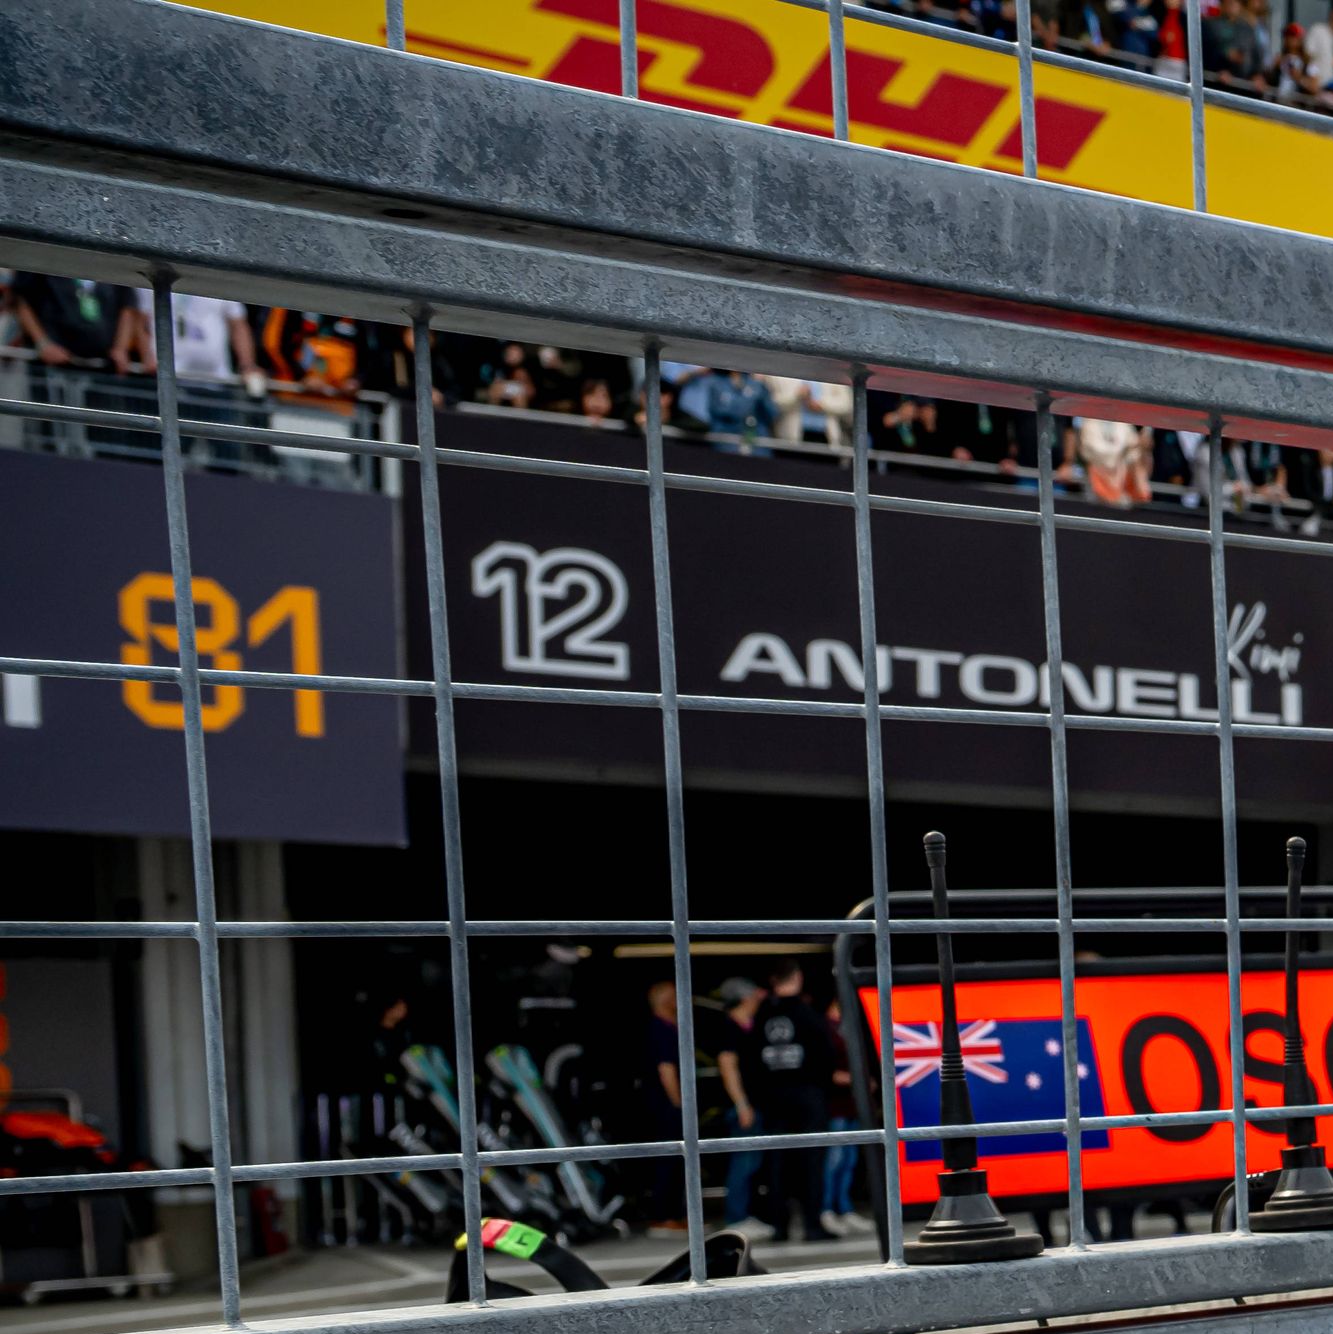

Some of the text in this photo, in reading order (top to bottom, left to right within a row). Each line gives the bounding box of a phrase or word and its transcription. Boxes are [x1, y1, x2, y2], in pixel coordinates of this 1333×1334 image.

[117, 570, 326, 738] 81
[471, 541, 630, 681] 12
[718, 632, 1303, 726] ANTONELLI
